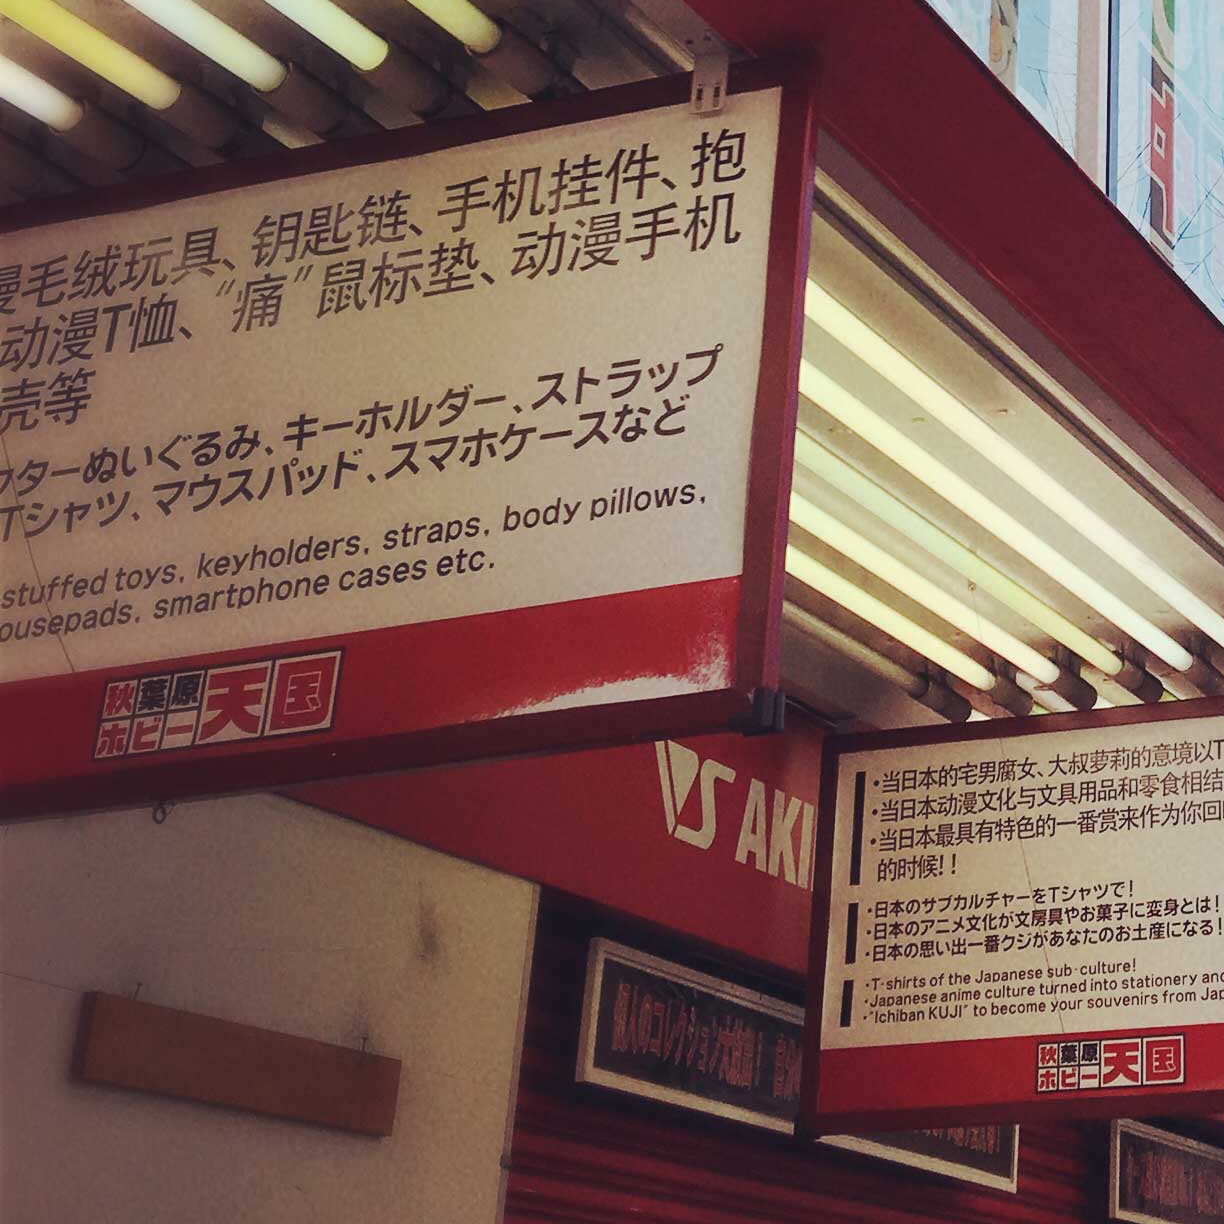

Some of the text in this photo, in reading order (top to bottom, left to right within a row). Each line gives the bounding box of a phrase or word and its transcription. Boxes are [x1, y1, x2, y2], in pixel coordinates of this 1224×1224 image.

[2, 568, 108, 609] stuffed
[503, 497, 582, 533] body
[153, 574, 330, 620] smartphone
[338, 559, 427, 591] cases
[436, 548, 495, 577] etc.
[103, 669, 204, 718] 秋葉原
[94, 710, 198, 758] ホビー
[869, 992, 937, 1008] Japanese
[940, 988, 981, 1002] anime
[984, 983, 1036, 999] culture
[1040, 979, 1087, 996] turned
[1090, 977, 1118, 992] into
[1121, 973, 1198, 991] stationery
[929, 974, 945, 987] of
[948, 972, 971, 986] the
[974, 967, 1043, 984] Japanese
[973, 1004, 988, 1017] to
[990, 1001, 1047, 1016] become
[1050, 998, 1083, 1013] your
[1087, 992, 1159, 1010] souvenirs
[1162, 989, 1197, 1003] from
[1038, 1042, 1099, 1067] 秋葉原
[1038, 1066, 1099, 1092] ホビー
